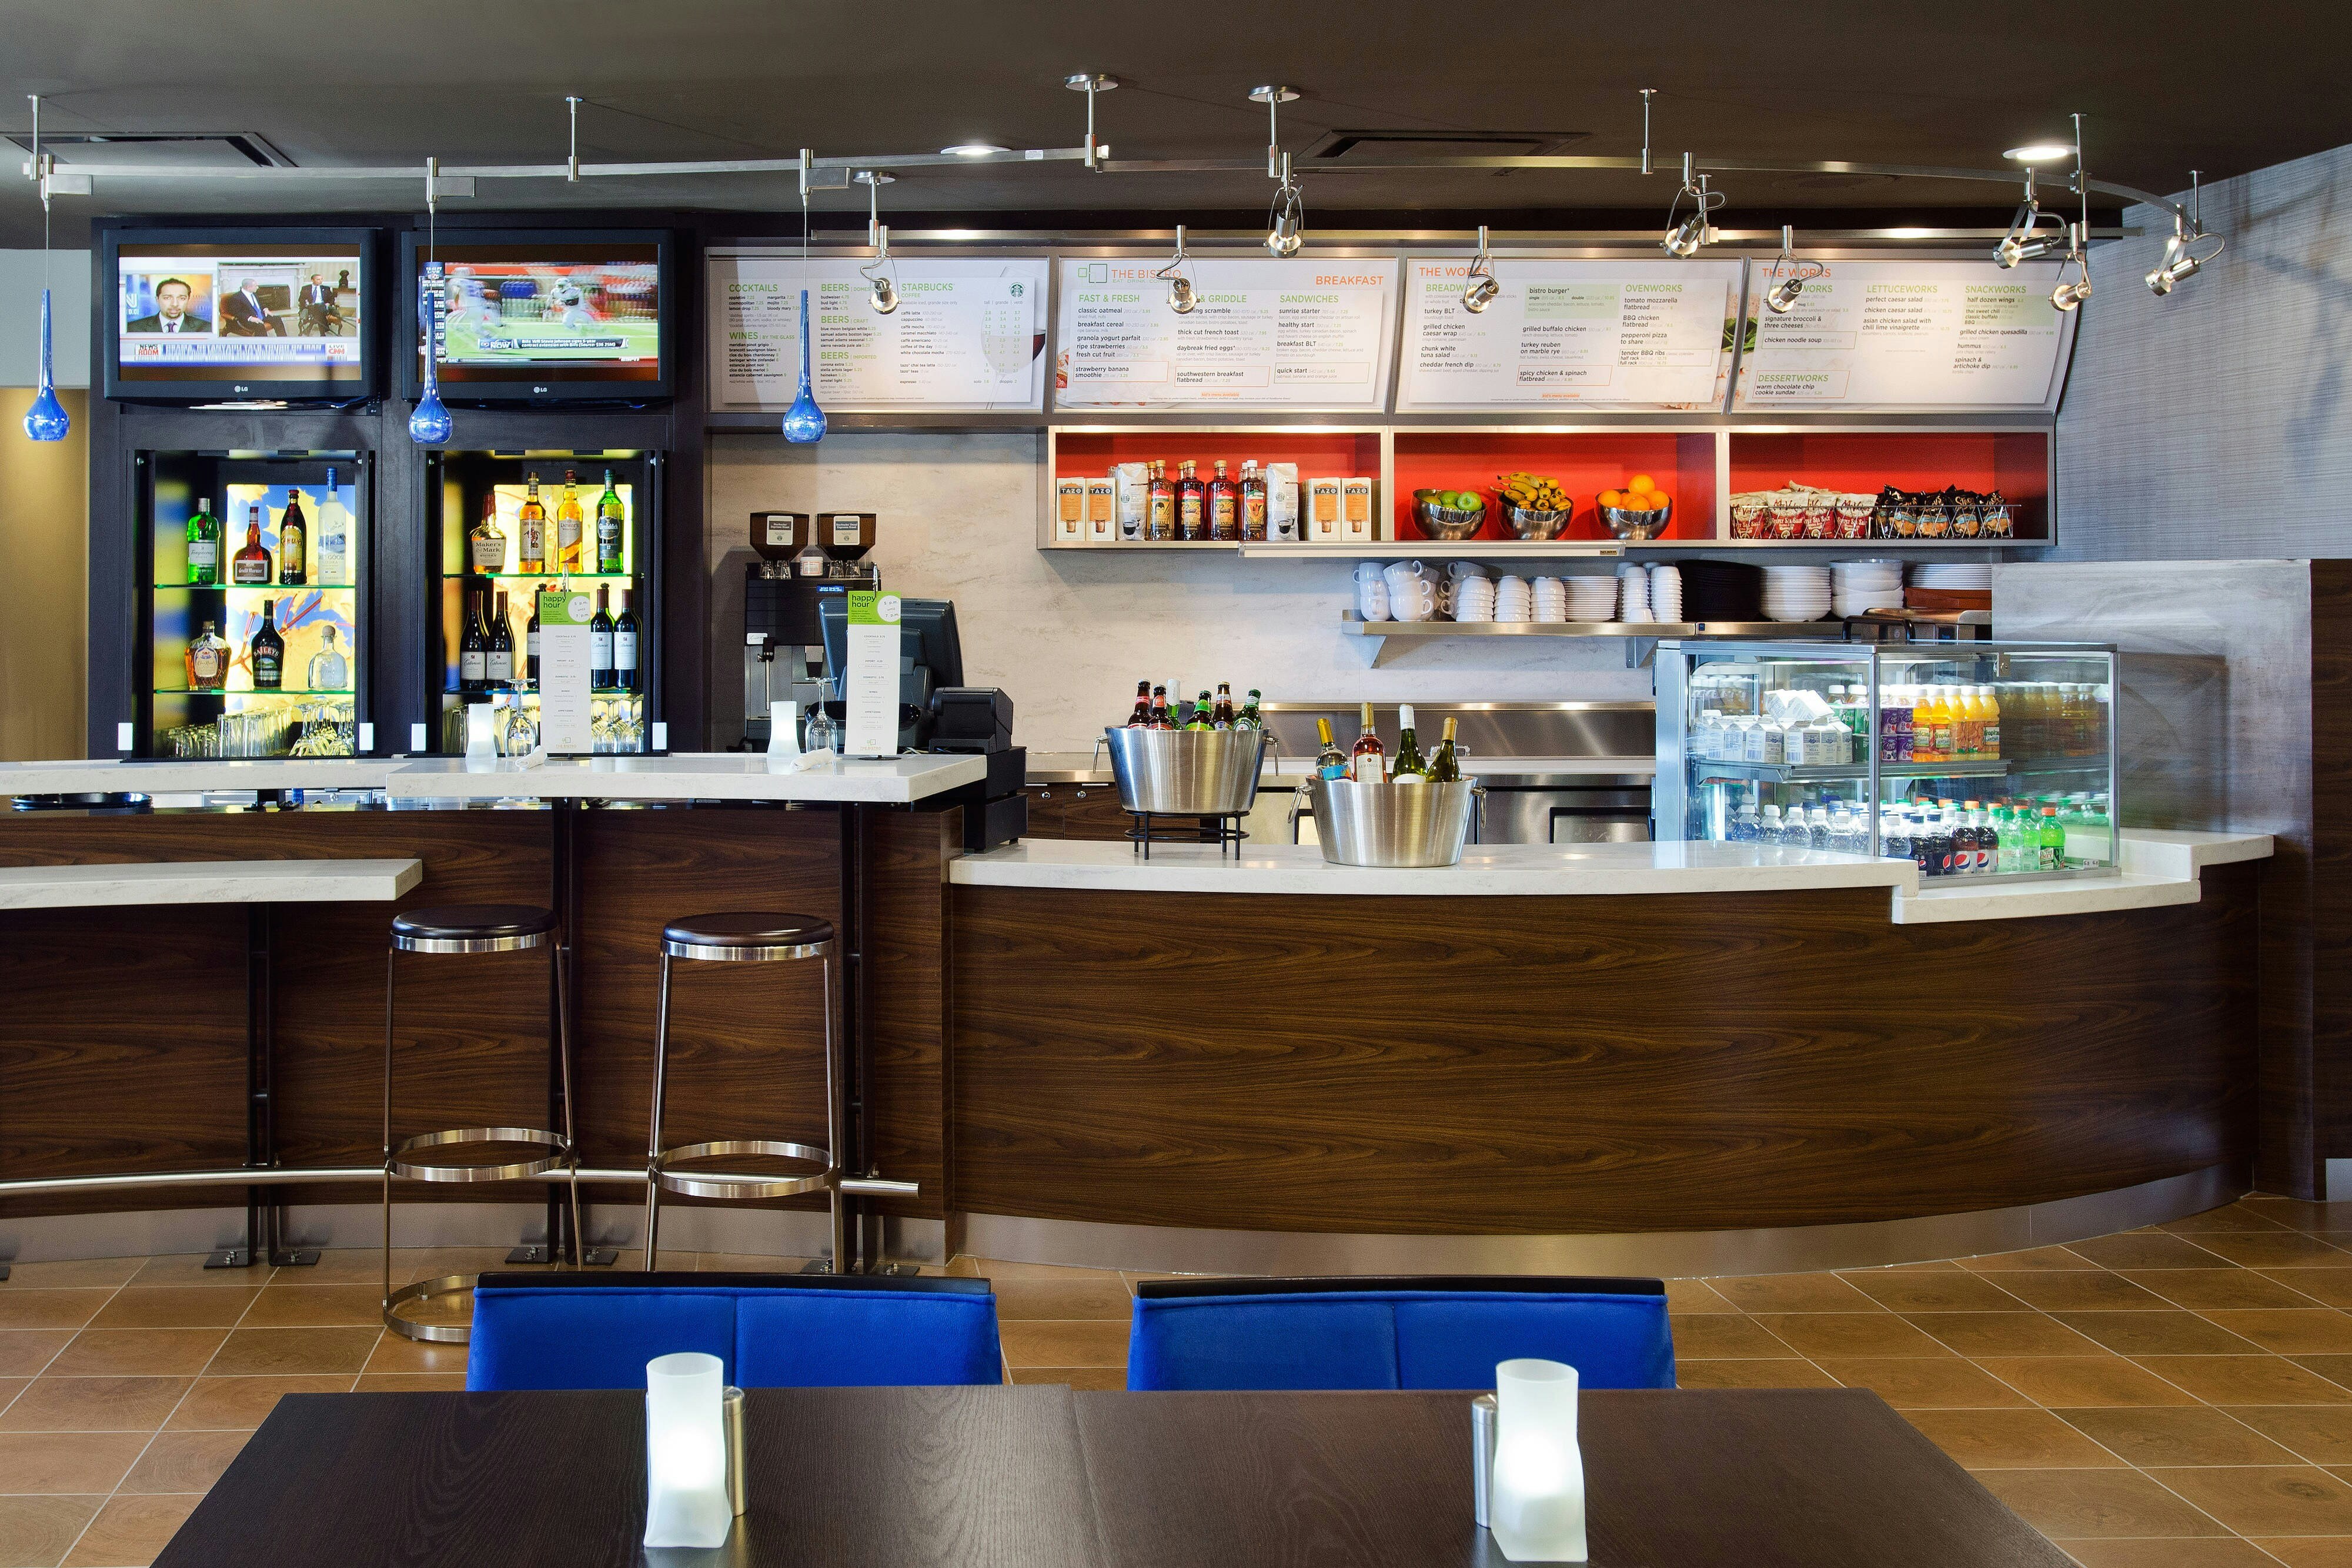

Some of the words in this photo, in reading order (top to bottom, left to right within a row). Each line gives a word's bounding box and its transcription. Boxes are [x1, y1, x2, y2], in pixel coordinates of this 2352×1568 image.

[1111, 269, 1134, 278] THE
[1419, 268, 1441, 276] THE
[1445, 267, 1489, 276] WORKS
[1762, 268, 1784, 278] THE
[1788, 268, 1832, 278] WORKS
[1317, 276, 1384, 285] BREAKFAST
[253, 646, 279, 657] BAILEYS
